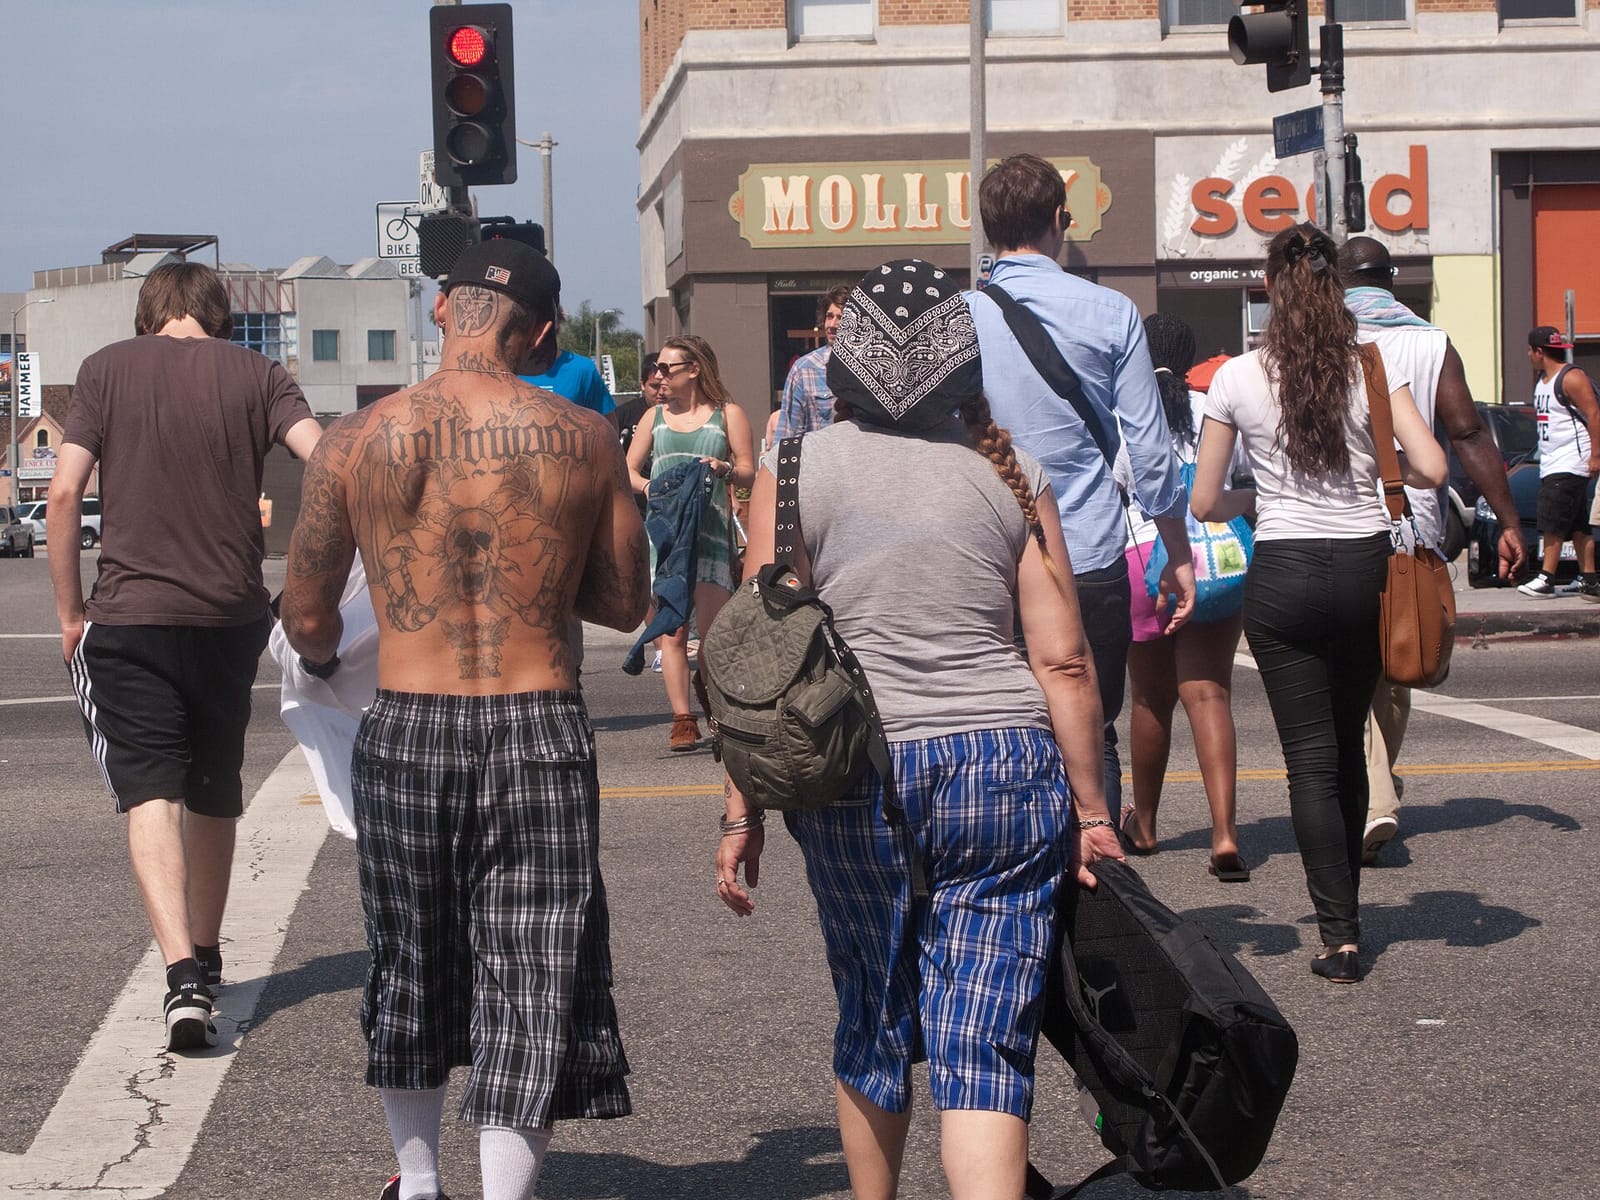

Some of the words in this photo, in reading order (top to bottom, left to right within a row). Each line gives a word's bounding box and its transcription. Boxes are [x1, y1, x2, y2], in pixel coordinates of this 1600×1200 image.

[1190, 145, 1430, 236] sed
[761, 169, 1080, 236] MOLLU
[387, 244, 411, 255] BIKE
[401, 263, 422, 274] BEG
[1190, 268, 1238, 282] organic
[19, 353, 31, 417] HAMMER
[180, 982, 198, 990] NIKE
